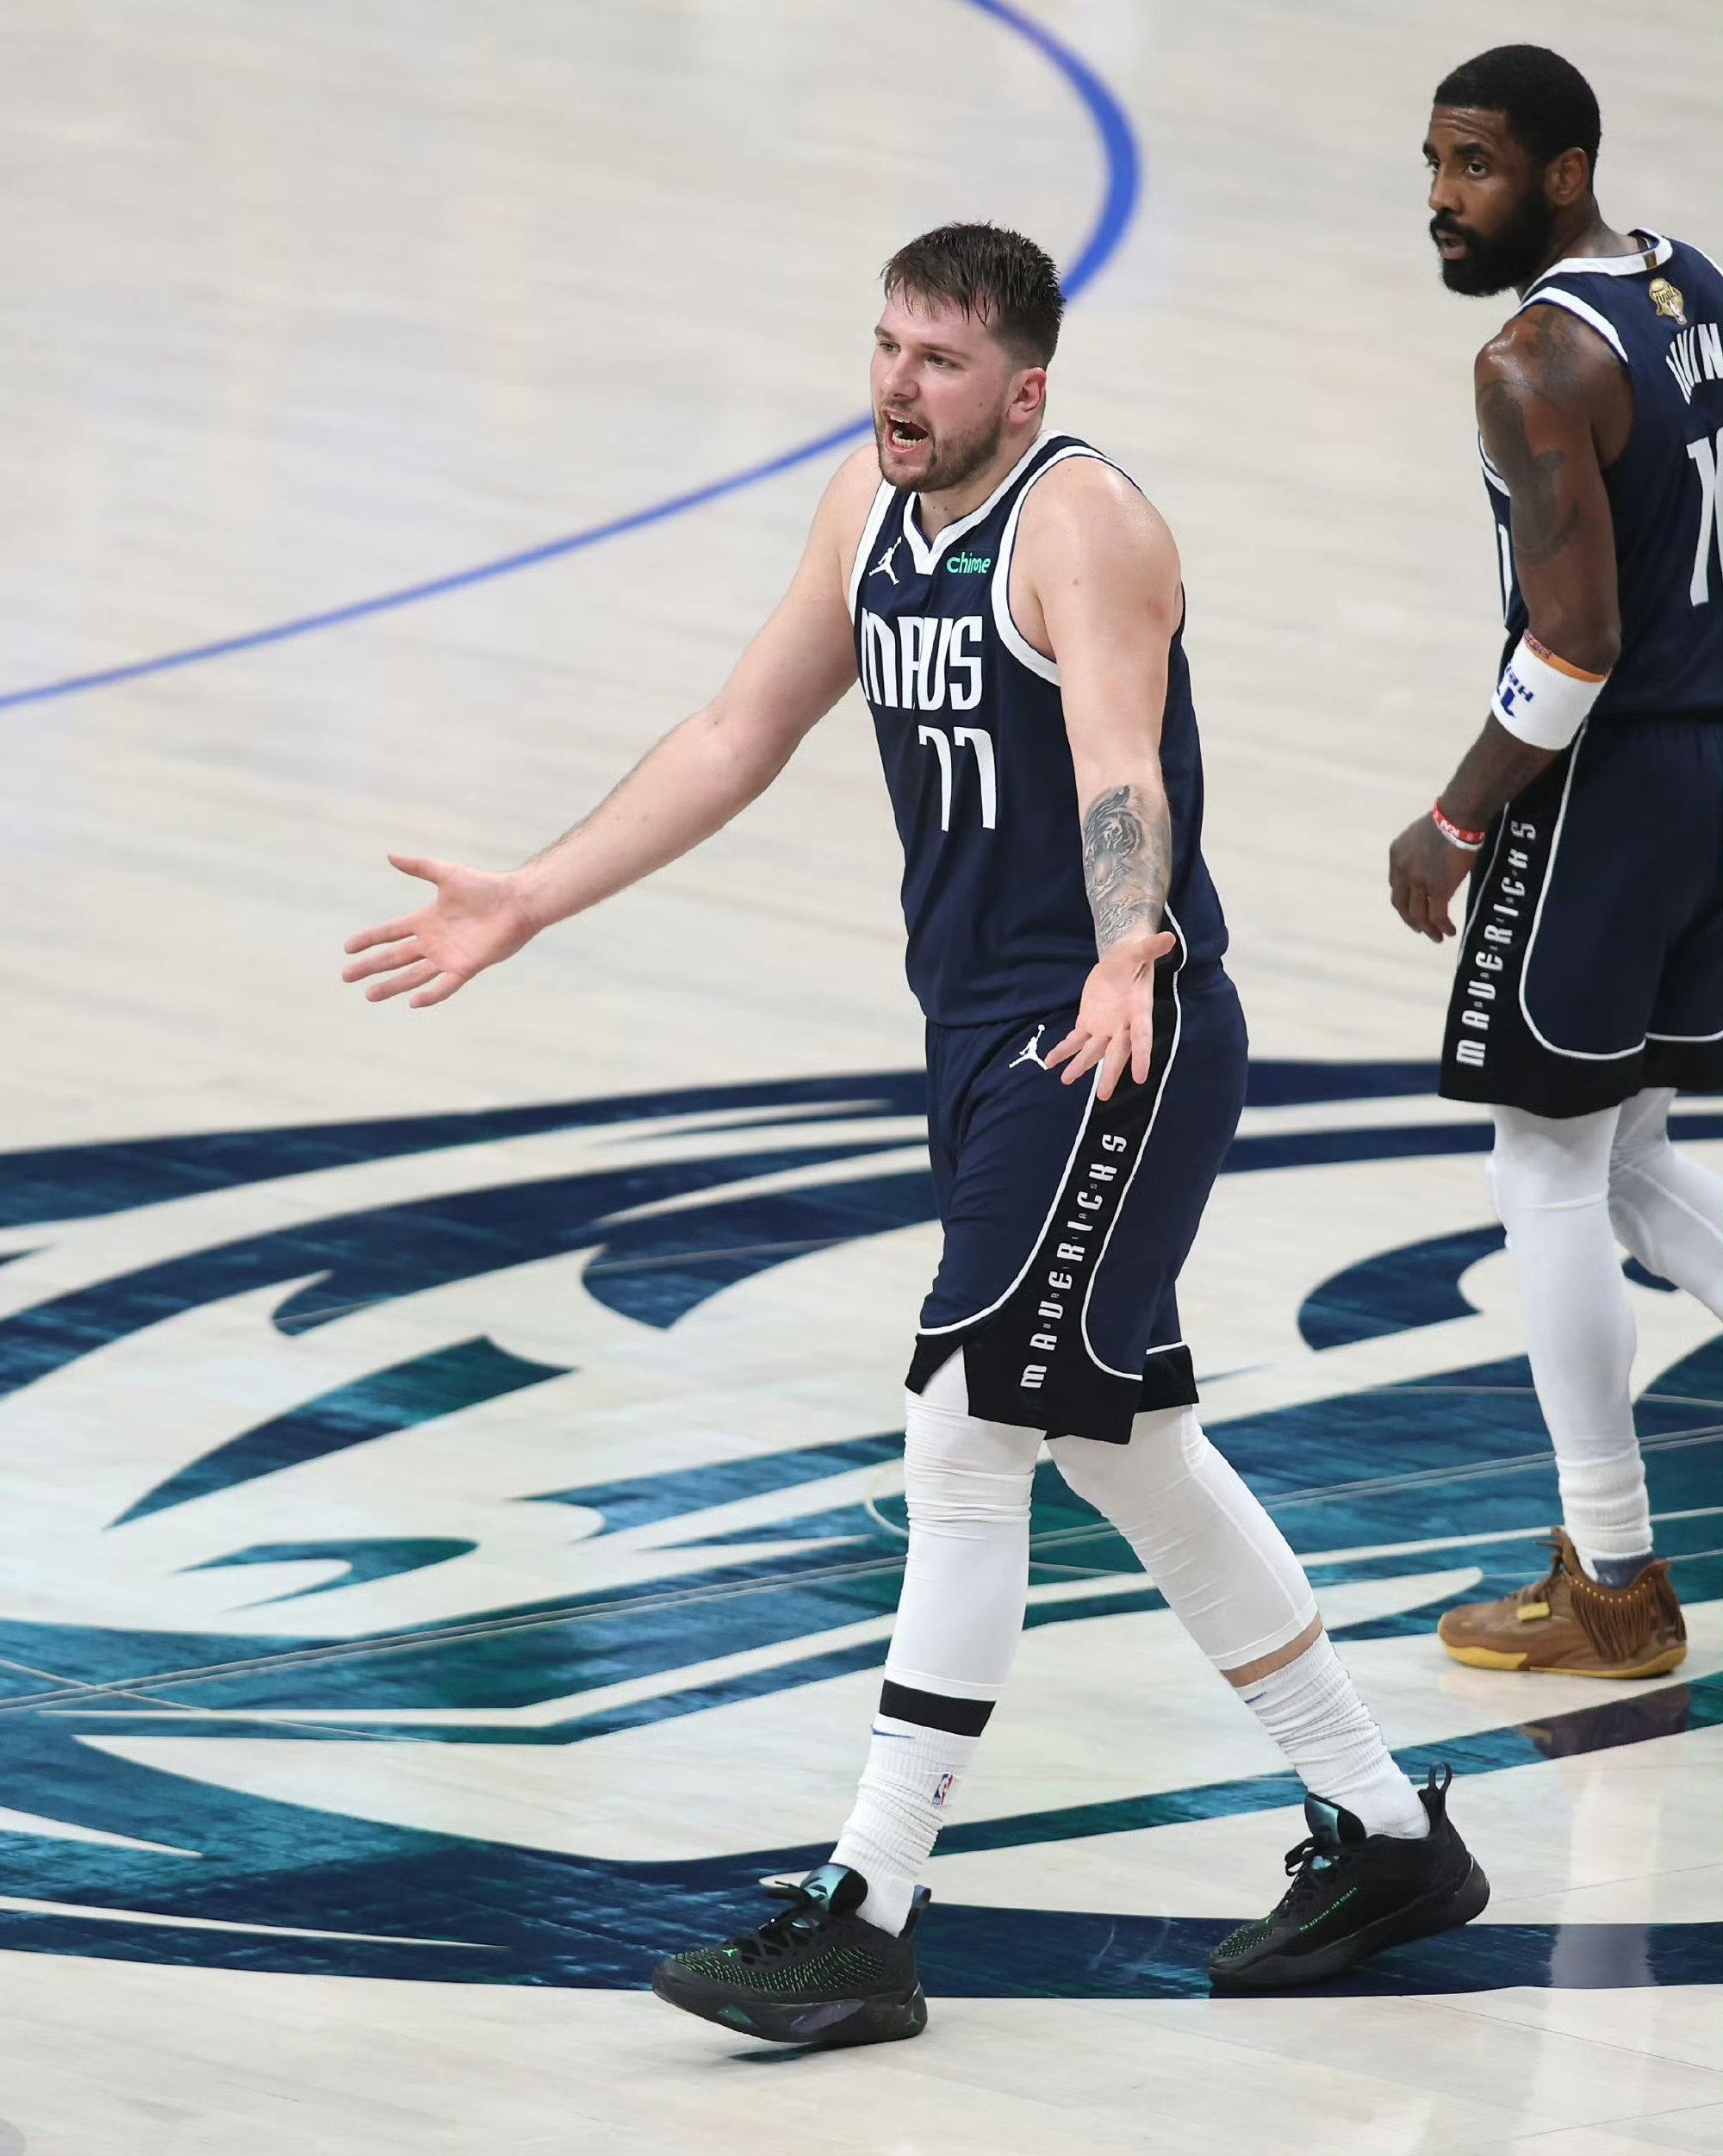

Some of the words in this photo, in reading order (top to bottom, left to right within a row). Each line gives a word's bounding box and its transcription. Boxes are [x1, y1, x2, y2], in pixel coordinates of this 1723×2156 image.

[947, 552, 991, 575] chime
[862, 607, 983, 711] MAVS
[918, 725, 997, 832] 77
[1457, 823, 1537, 1067] MAVERICKS
[1020, 1134, 1127, 1389] MAVERICKS
